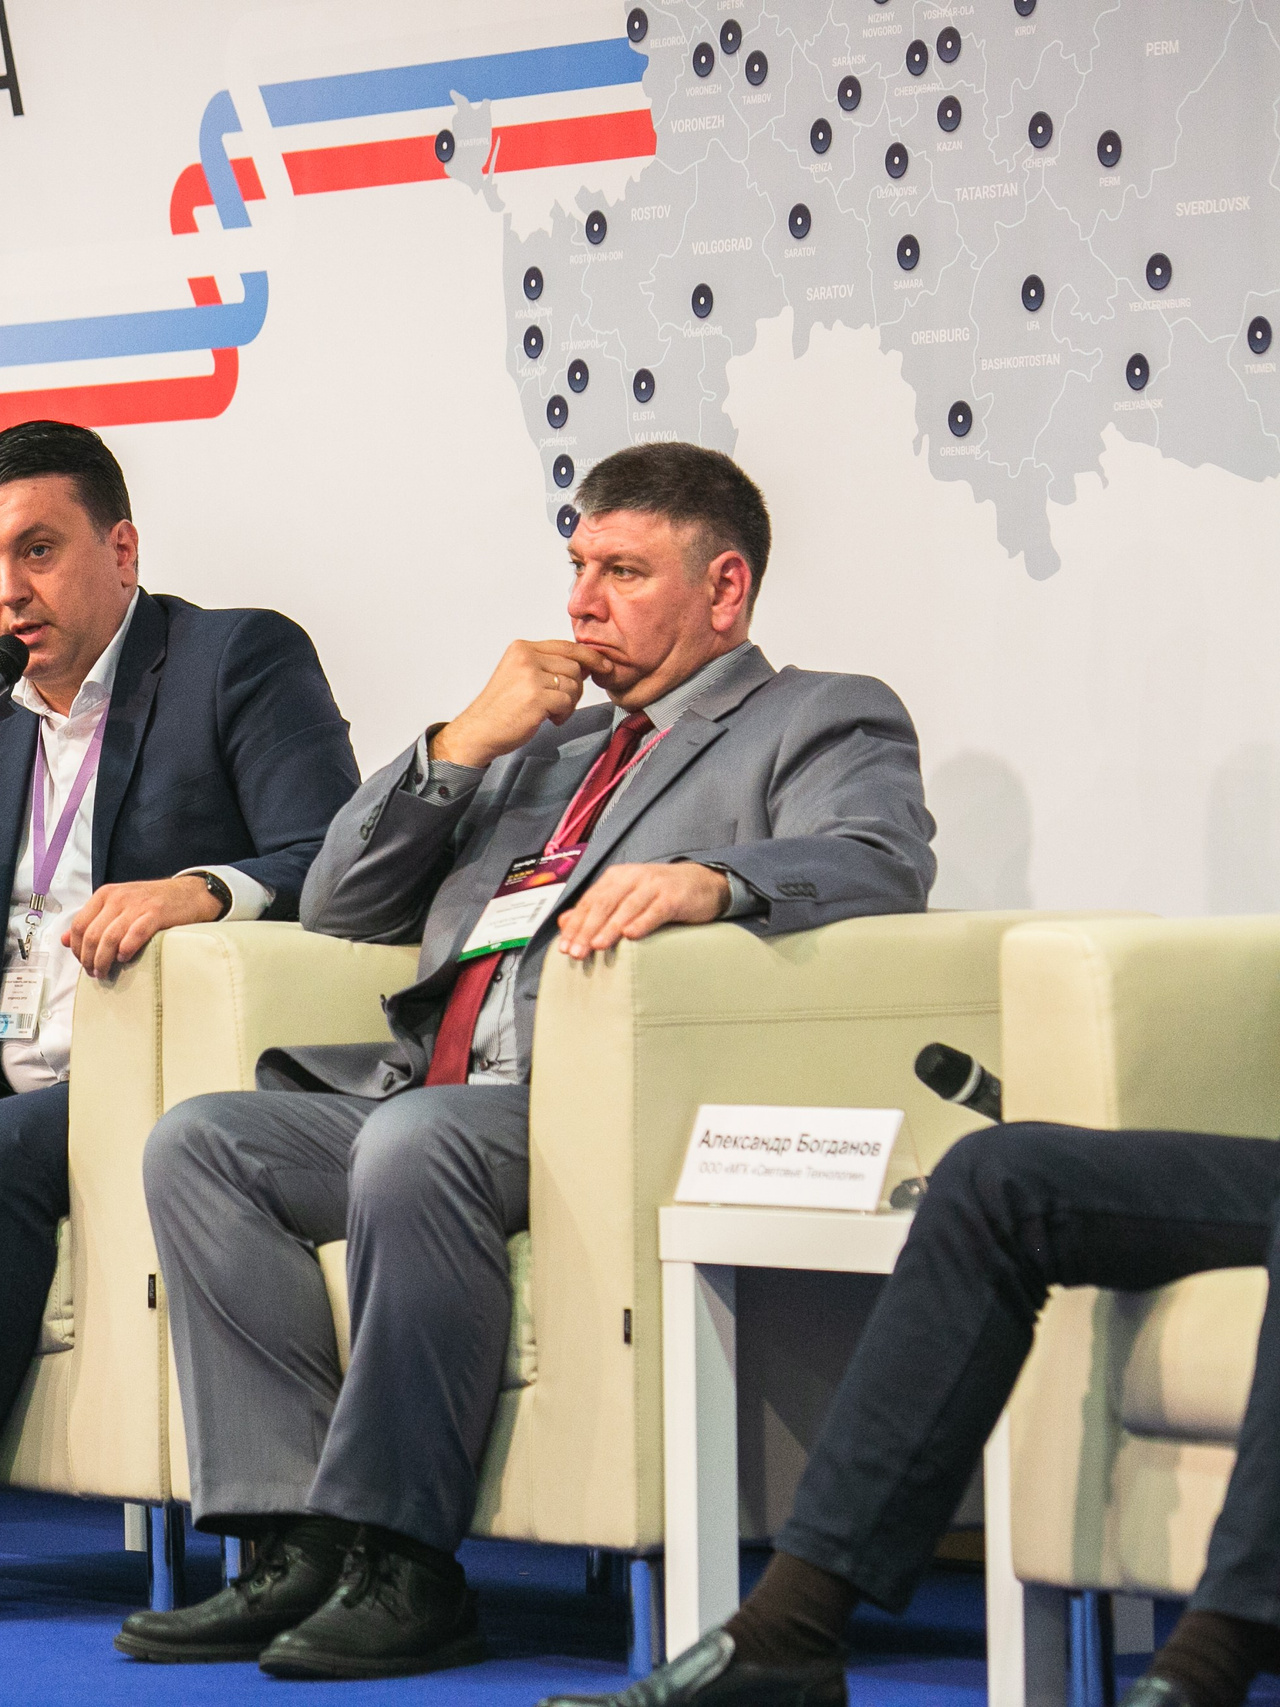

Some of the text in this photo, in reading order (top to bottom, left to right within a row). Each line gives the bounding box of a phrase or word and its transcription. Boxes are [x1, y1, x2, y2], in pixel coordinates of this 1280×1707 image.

[868, 11, 895, 24] NIZHNY
[923, 5, 975, 20] YOSHKAR-OLA
[862, 25, 902, 38] NOVGOROD
[1014, 24, 1037, 37] KIROV
[650, 36, 686, 49] BELGOROD
[1145, 39, 1180, 57] PERM
[832, 54, 867, 67] SARANSK
[685, 84, 722, 97] VORONEZH
[742, 93, 772, 106] TAMBOV
[670, 115, 725, 134] VORONEZH
[455, 136, 490, 149] EVASTOPOL
[936, 140, 963, 152] KAZAN
[810, 162, 833, 173] PENZA
[1024, 156, 1057, 169] IZHEVSK
[1099, 176, 1121, 188] PERM
[876, 185, 918, 199] ULYANOVSK
[955, 182, 1018, 202] TATARSTAN
[1175, 196, 1251, 217] SVERDLOVSK
[631, 205, 671, 222] ROSTOV
[692, 237, 753, 255] VOLGOGRAD
[784, 246, 816, 259] SARATOV
[569, 251, 624, 265] ROSTOV-ON-DON
[893, 278, 924, 291] SAMARA
[806, 284, 854, 302] SARATOV
[1129, 298, 1192, 312] YEKATERINBURG
[1026, 320, 1040, 331] UFA
[911, 327, 971, 346] ORENBURG
[561, 340, 599, 351] STAVROPOL
[981, 353, 1060, 371] BASHKORTOSTAN
[1244, 363, 1276, 375] TYUMEN
[1113, 398, 1163, 412] CHELYABINSK
[632, 411, 656, 422] ELISTA
[634, 430, 678, 443] KALMYKIA
[940, 445, 981, 457] ORENBURG
[698, 1129, 881, 1157] Александр Богданов
[699, 1162, 721, 1174] ООО
